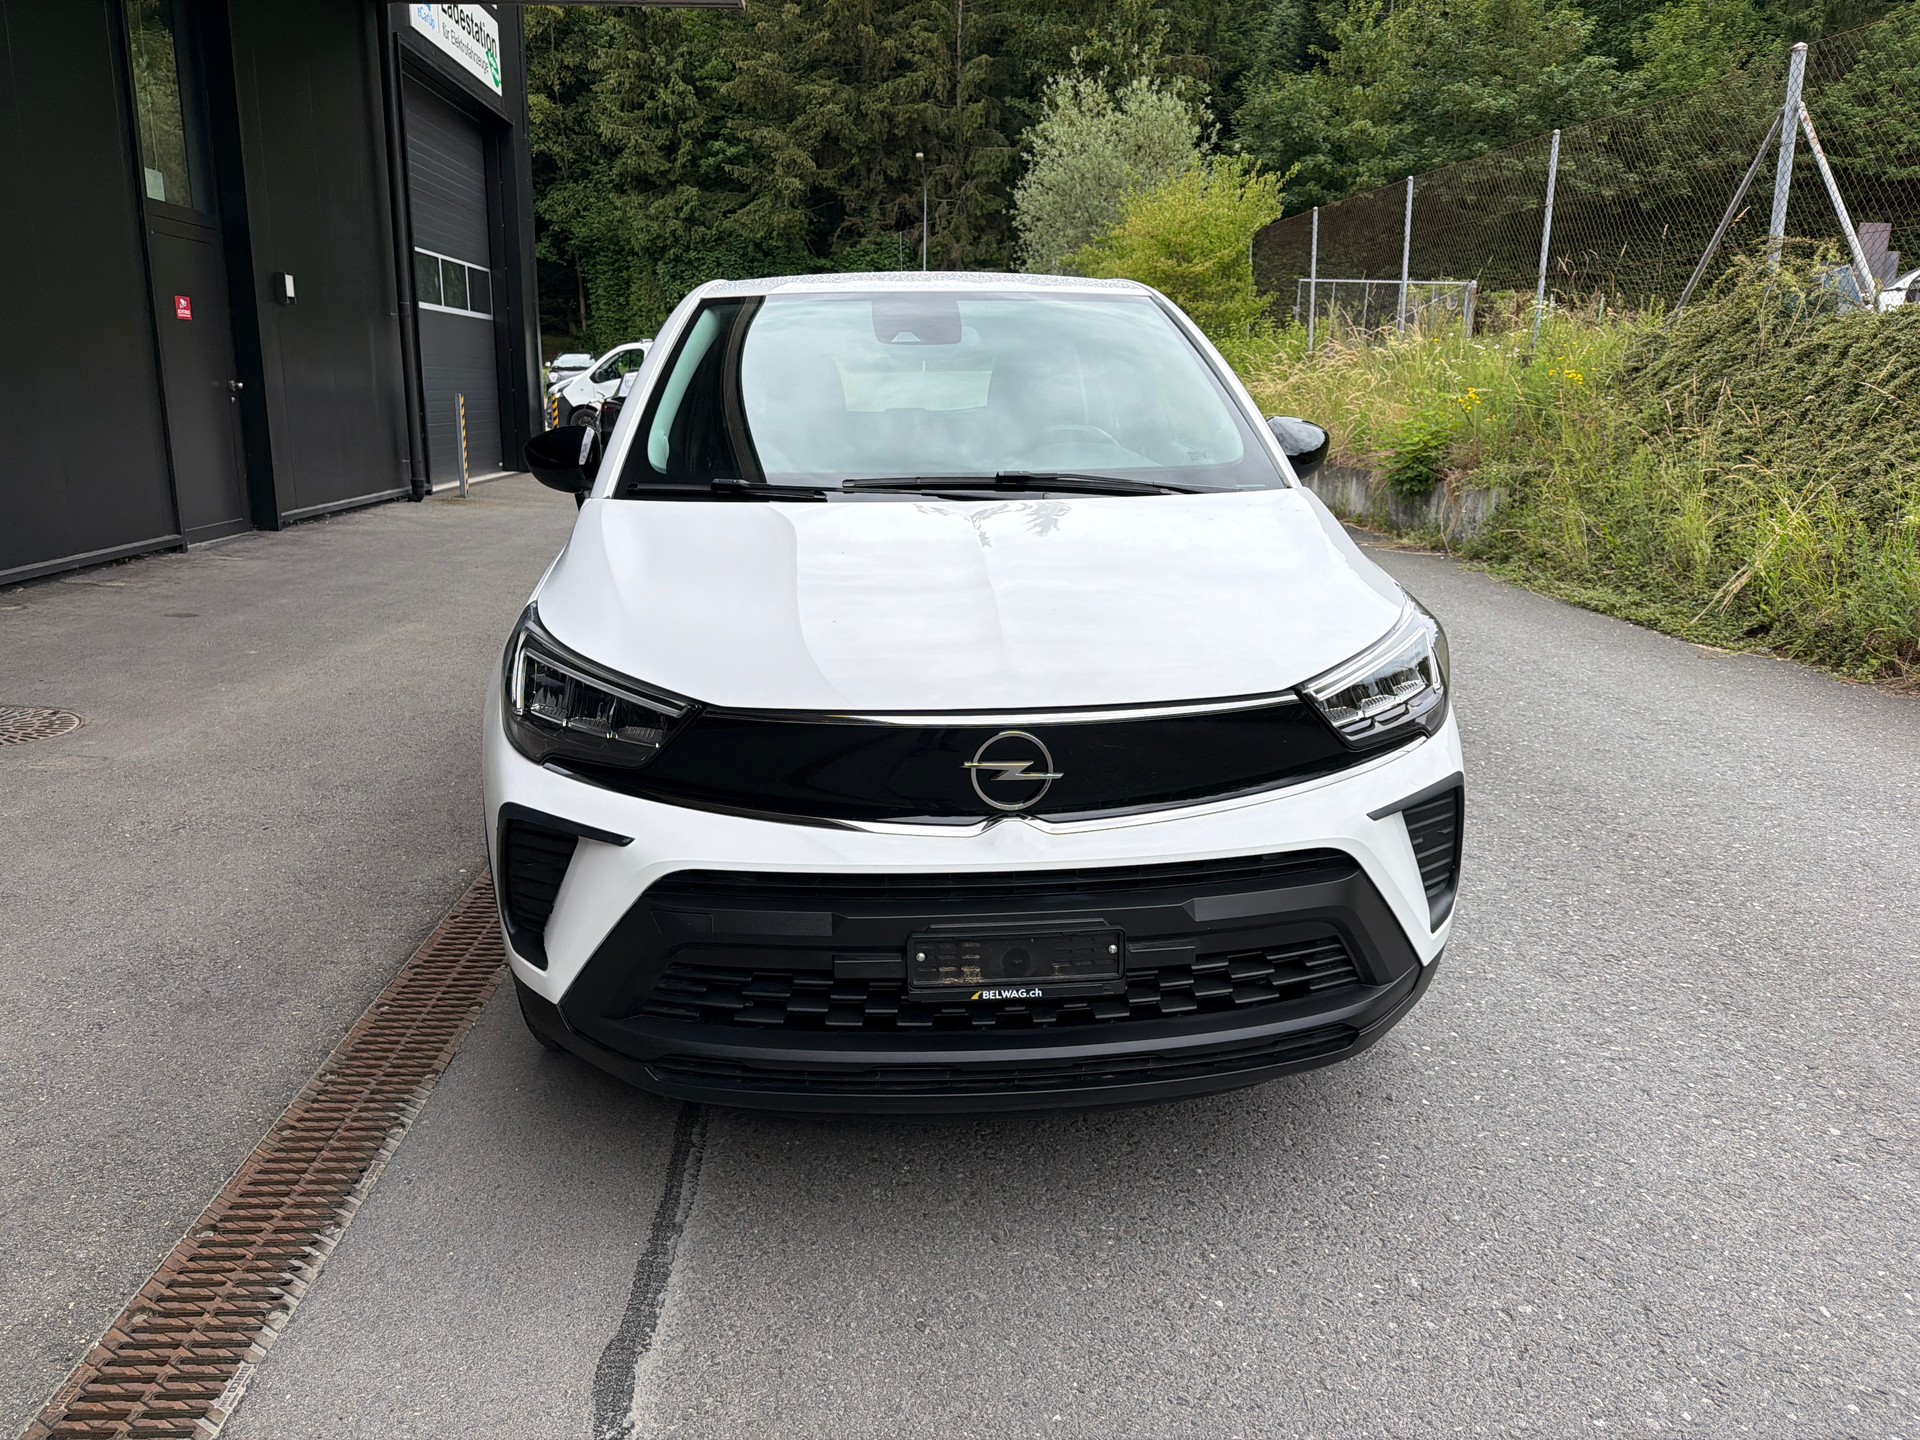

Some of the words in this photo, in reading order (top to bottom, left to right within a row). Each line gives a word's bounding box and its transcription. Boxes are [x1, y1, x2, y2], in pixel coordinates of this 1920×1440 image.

[442, 22, 450, 41] für
[450, 29, 489, 75] Elektrofahrzeuge
[982, 988, 1042, 999] BELWAG.ch
